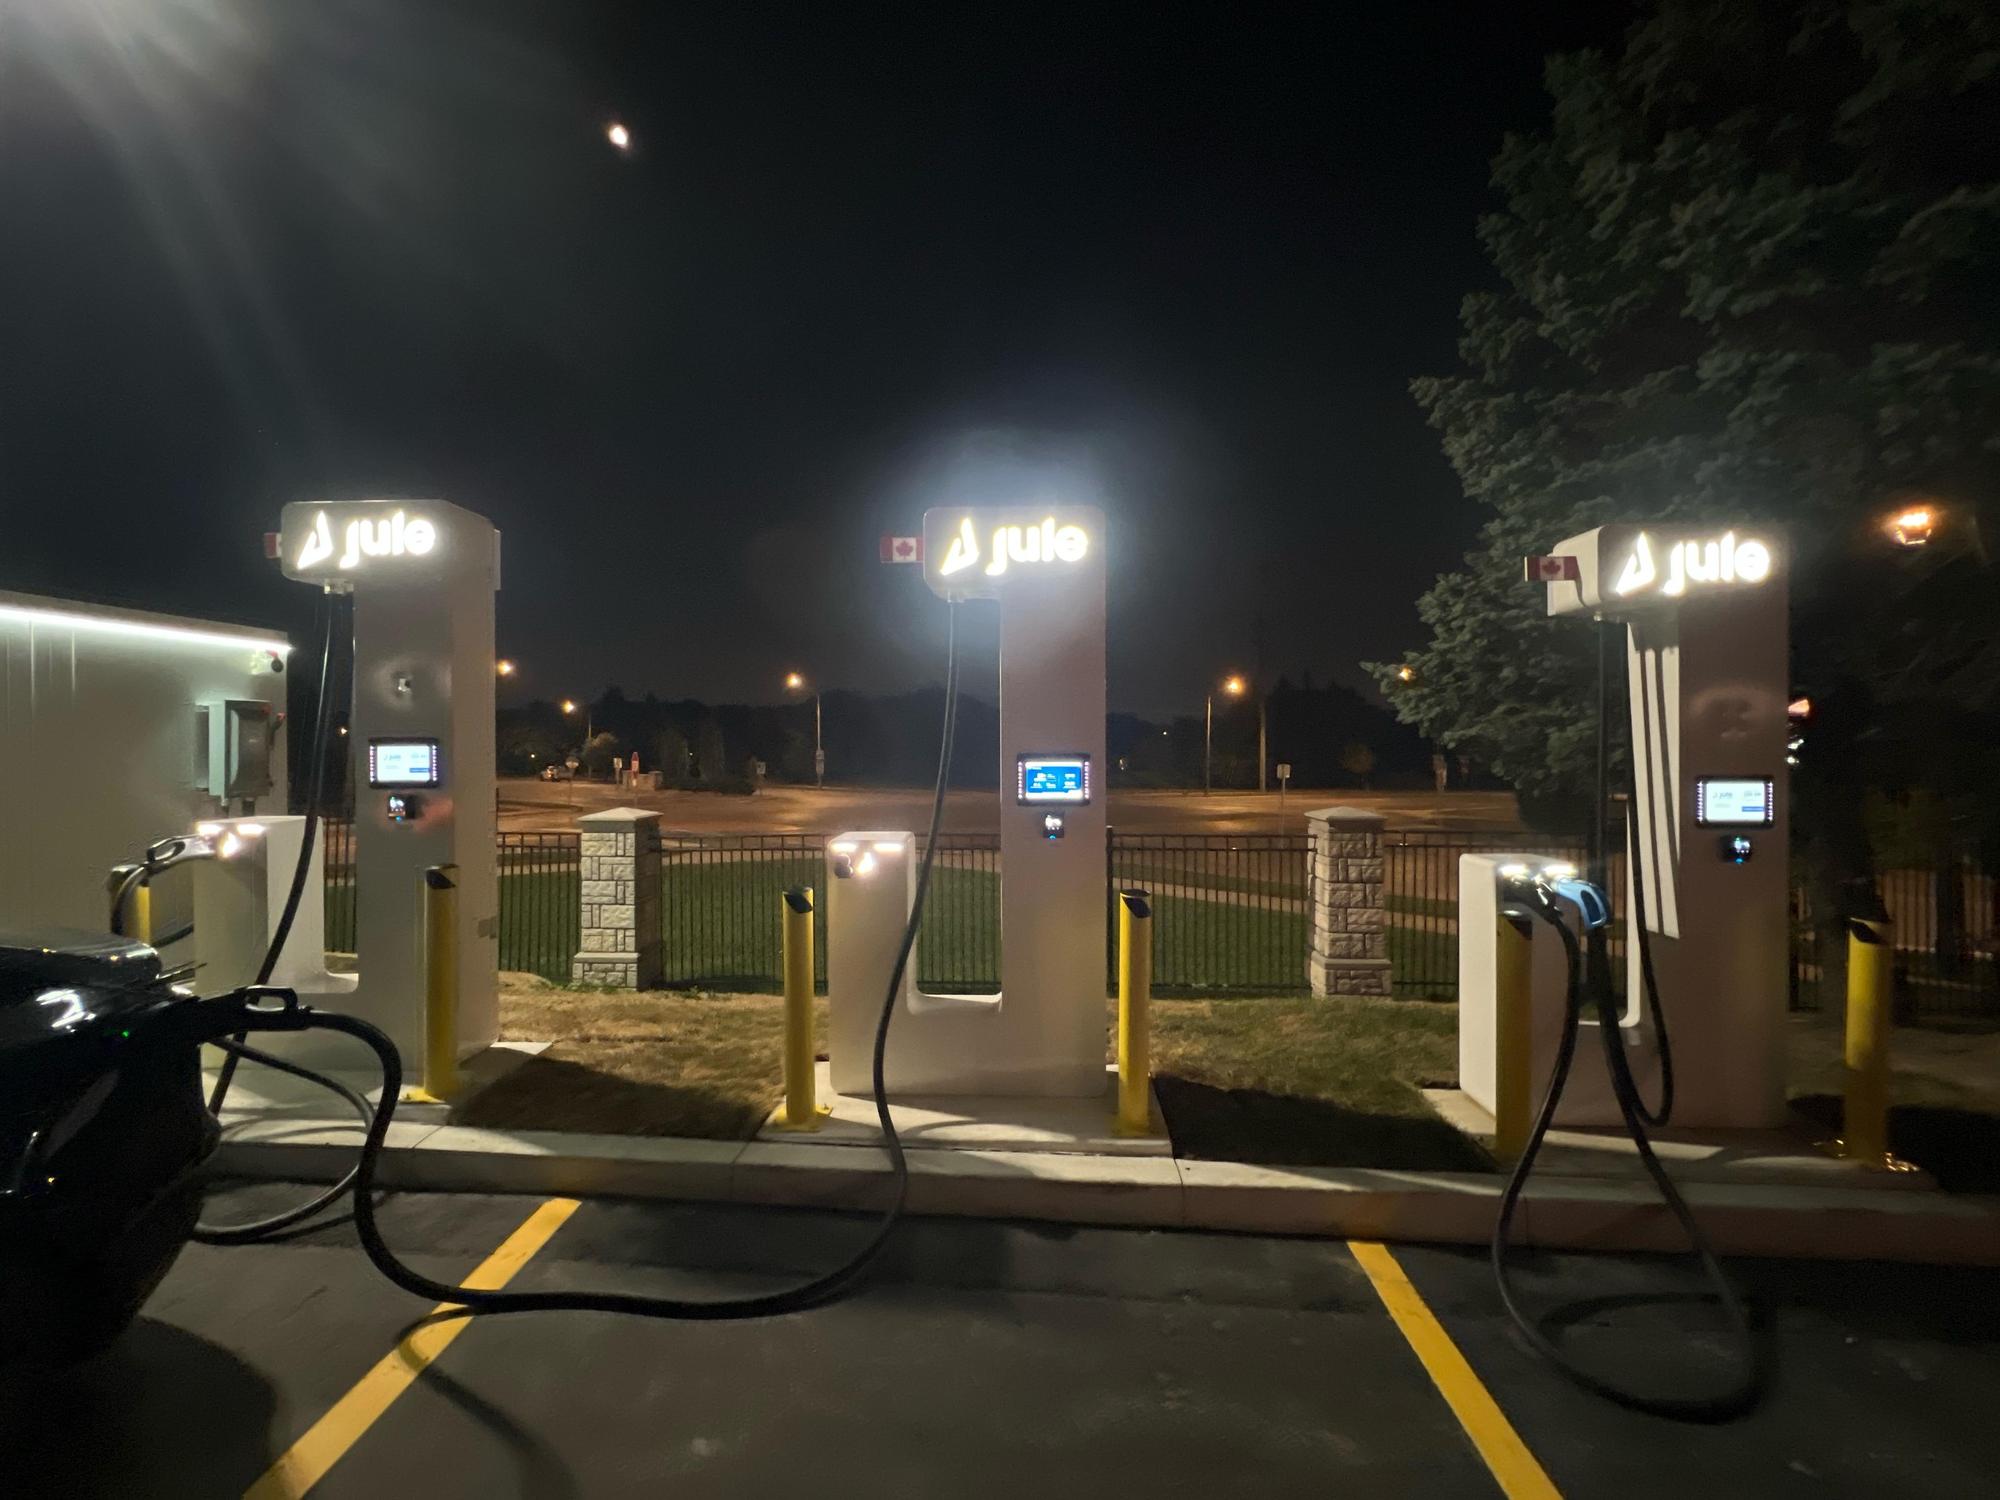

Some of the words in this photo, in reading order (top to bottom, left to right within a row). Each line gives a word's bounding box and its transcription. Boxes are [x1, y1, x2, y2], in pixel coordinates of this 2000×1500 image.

[339, 510, 436, 569] jule
[985, 516, 1088, 576] jule
[1662, 530, 1770, 595] jule
